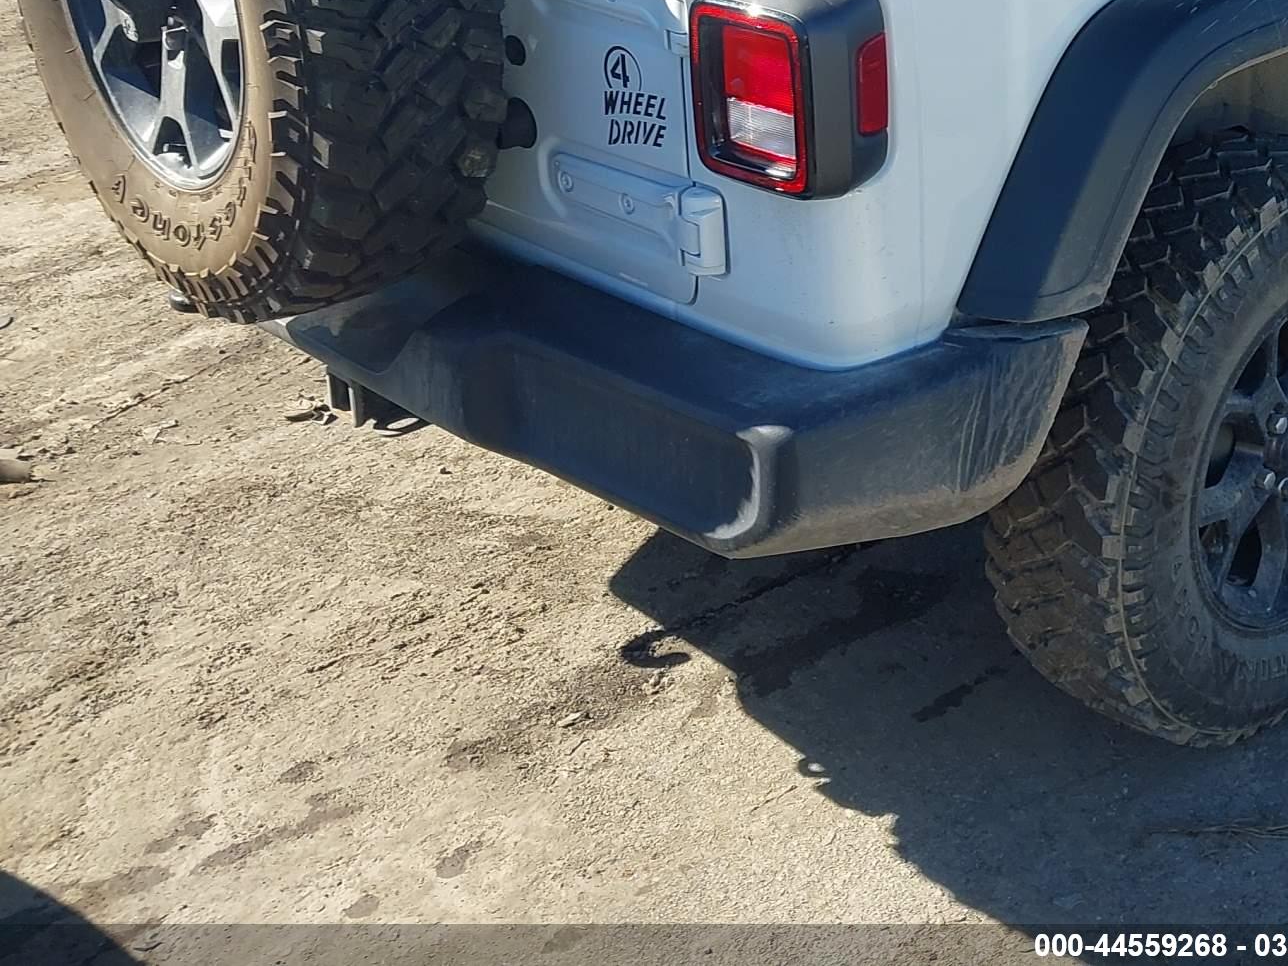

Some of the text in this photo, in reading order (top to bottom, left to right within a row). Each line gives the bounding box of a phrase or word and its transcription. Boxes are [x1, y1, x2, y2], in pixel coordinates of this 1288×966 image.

[610, 53, 630, 89] 4
[604, 90, 667, 120] WHEEL
[608, 118, 667, 148] DRIVE
